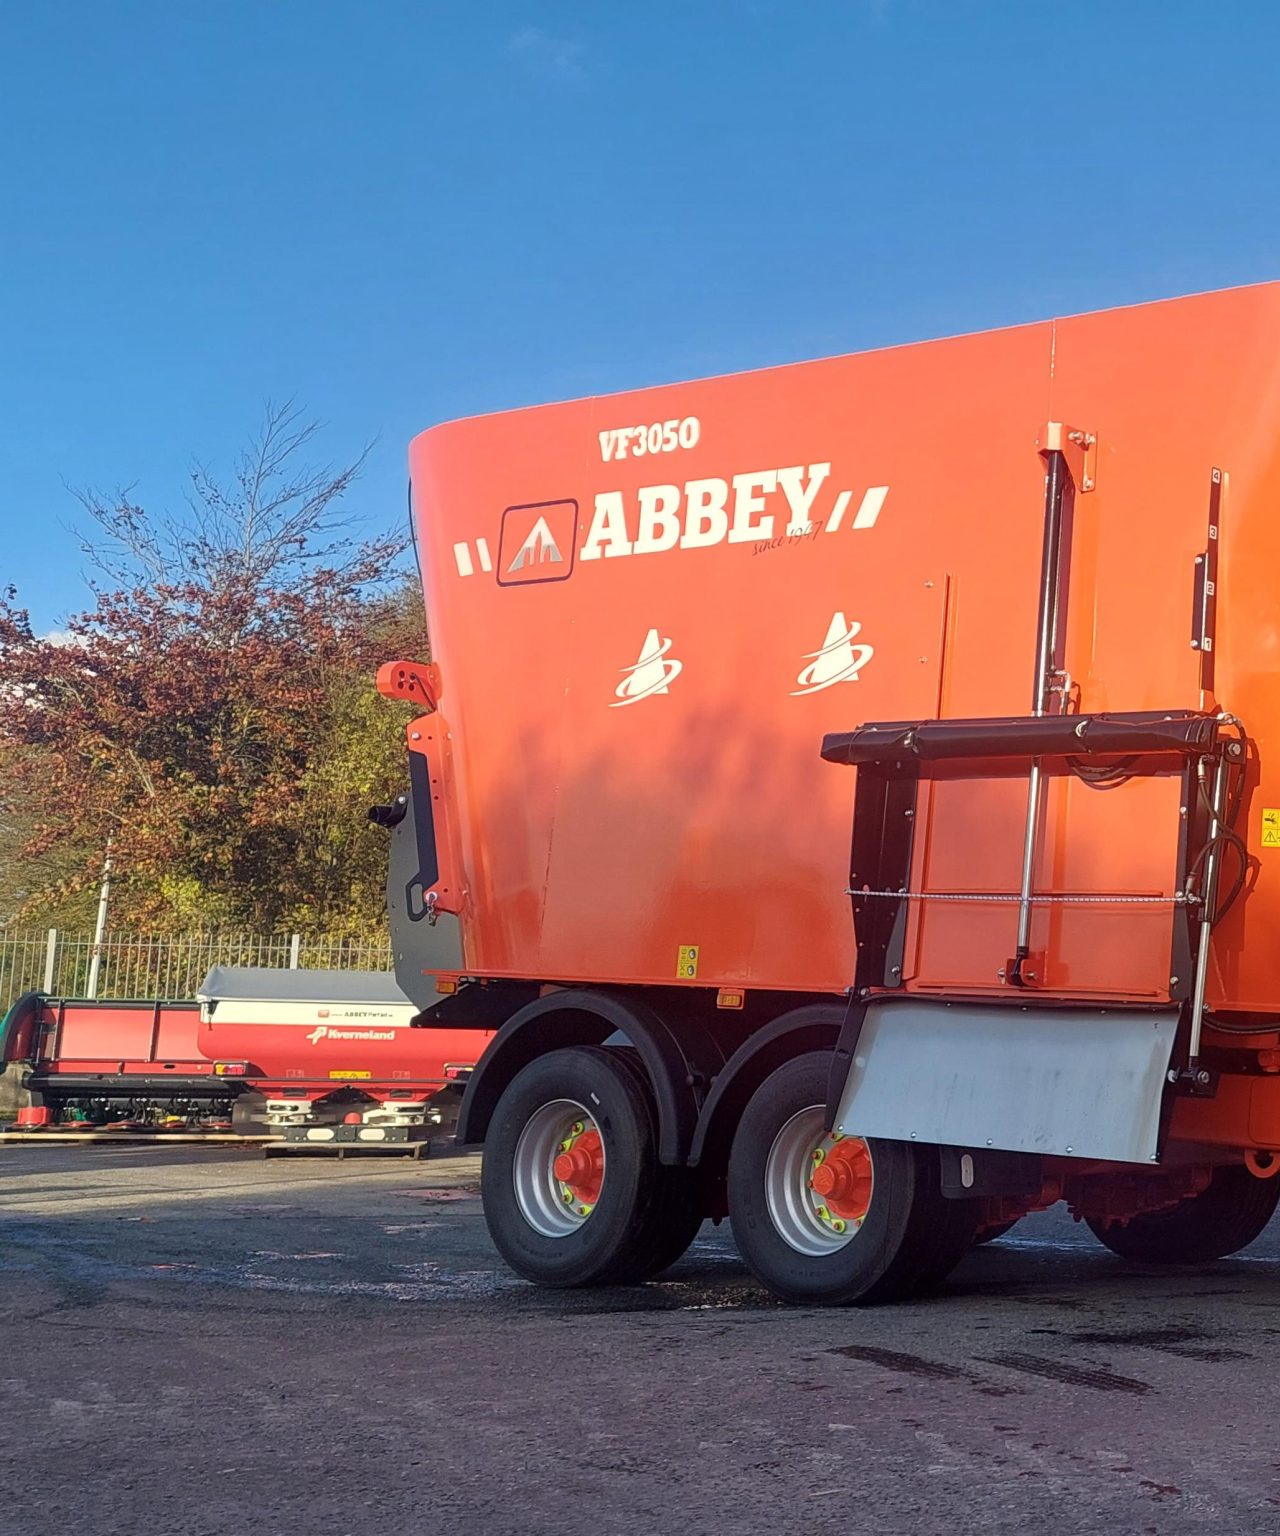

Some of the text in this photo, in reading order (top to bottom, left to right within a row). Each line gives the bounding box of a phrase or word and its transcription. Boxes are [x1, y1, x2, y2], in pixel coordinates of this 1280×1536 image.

[598, 417, 700, 462] VF3050
[580, 462, 831, 561] ABBEY
[752, 535, 784, 556] since
[328, 1029, 395, 1040] Kverneland
